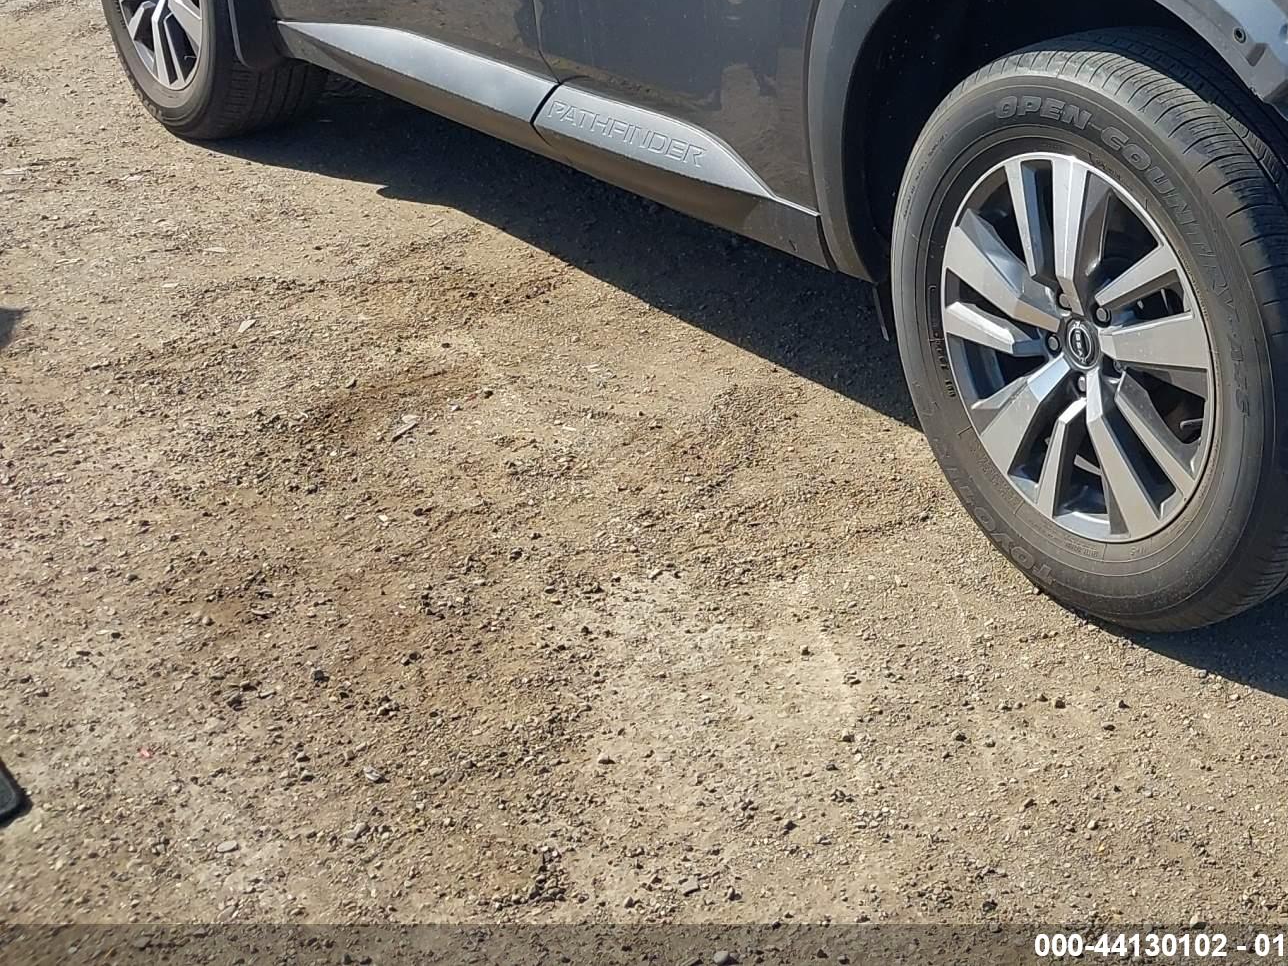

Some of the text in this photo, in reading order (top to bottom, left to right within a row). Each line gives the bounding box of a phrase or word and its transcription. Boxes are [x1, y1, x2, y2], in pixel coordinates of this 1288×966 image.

[547, 100, 708, 168] PATHFINDER
[995, 94, 1093, 131] OPEN
[972, 505, 1056, 586] TOYO
